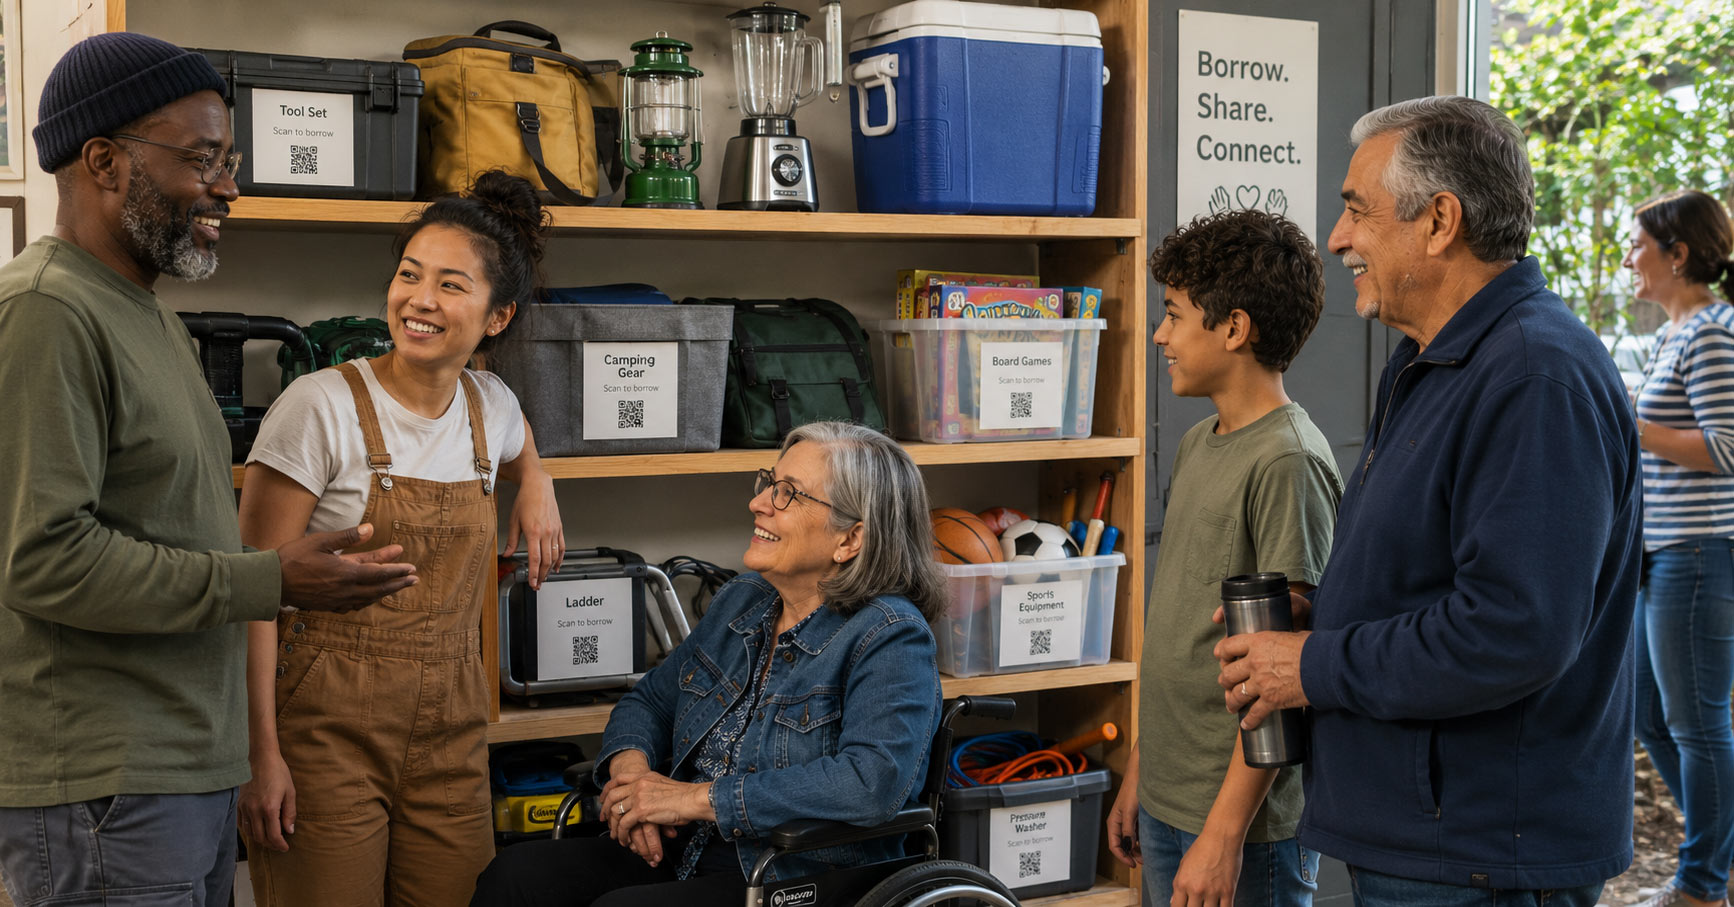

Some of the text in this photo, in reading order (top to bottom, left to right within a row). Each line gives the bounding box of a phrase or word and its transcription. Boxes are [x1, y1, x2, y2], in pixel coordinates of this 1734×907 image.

[1198, 50, 1288, 82] Borrow.
[280, 105, 327, 118] Tool Set
[1197, 92, 1273, 122] Share.
[273, 126, 334, 137] Scan to borrow
[1197, 134, 1301, 164] Connect.
[604, 354, 655, 367] Camping
[992, 356, 1052, 366] Board Games
[618, 367, 645, 378] Gear
[603, 384, 659, 392] Scan to borrow
[1027, 590, 1054, 601] Sports
[566, 596, 604, 608] Ladder
[1019, 601, 1064, 613] Equipment
[557, 619, 575, 628] Scan
[586, 618, 613, 626] borrow
